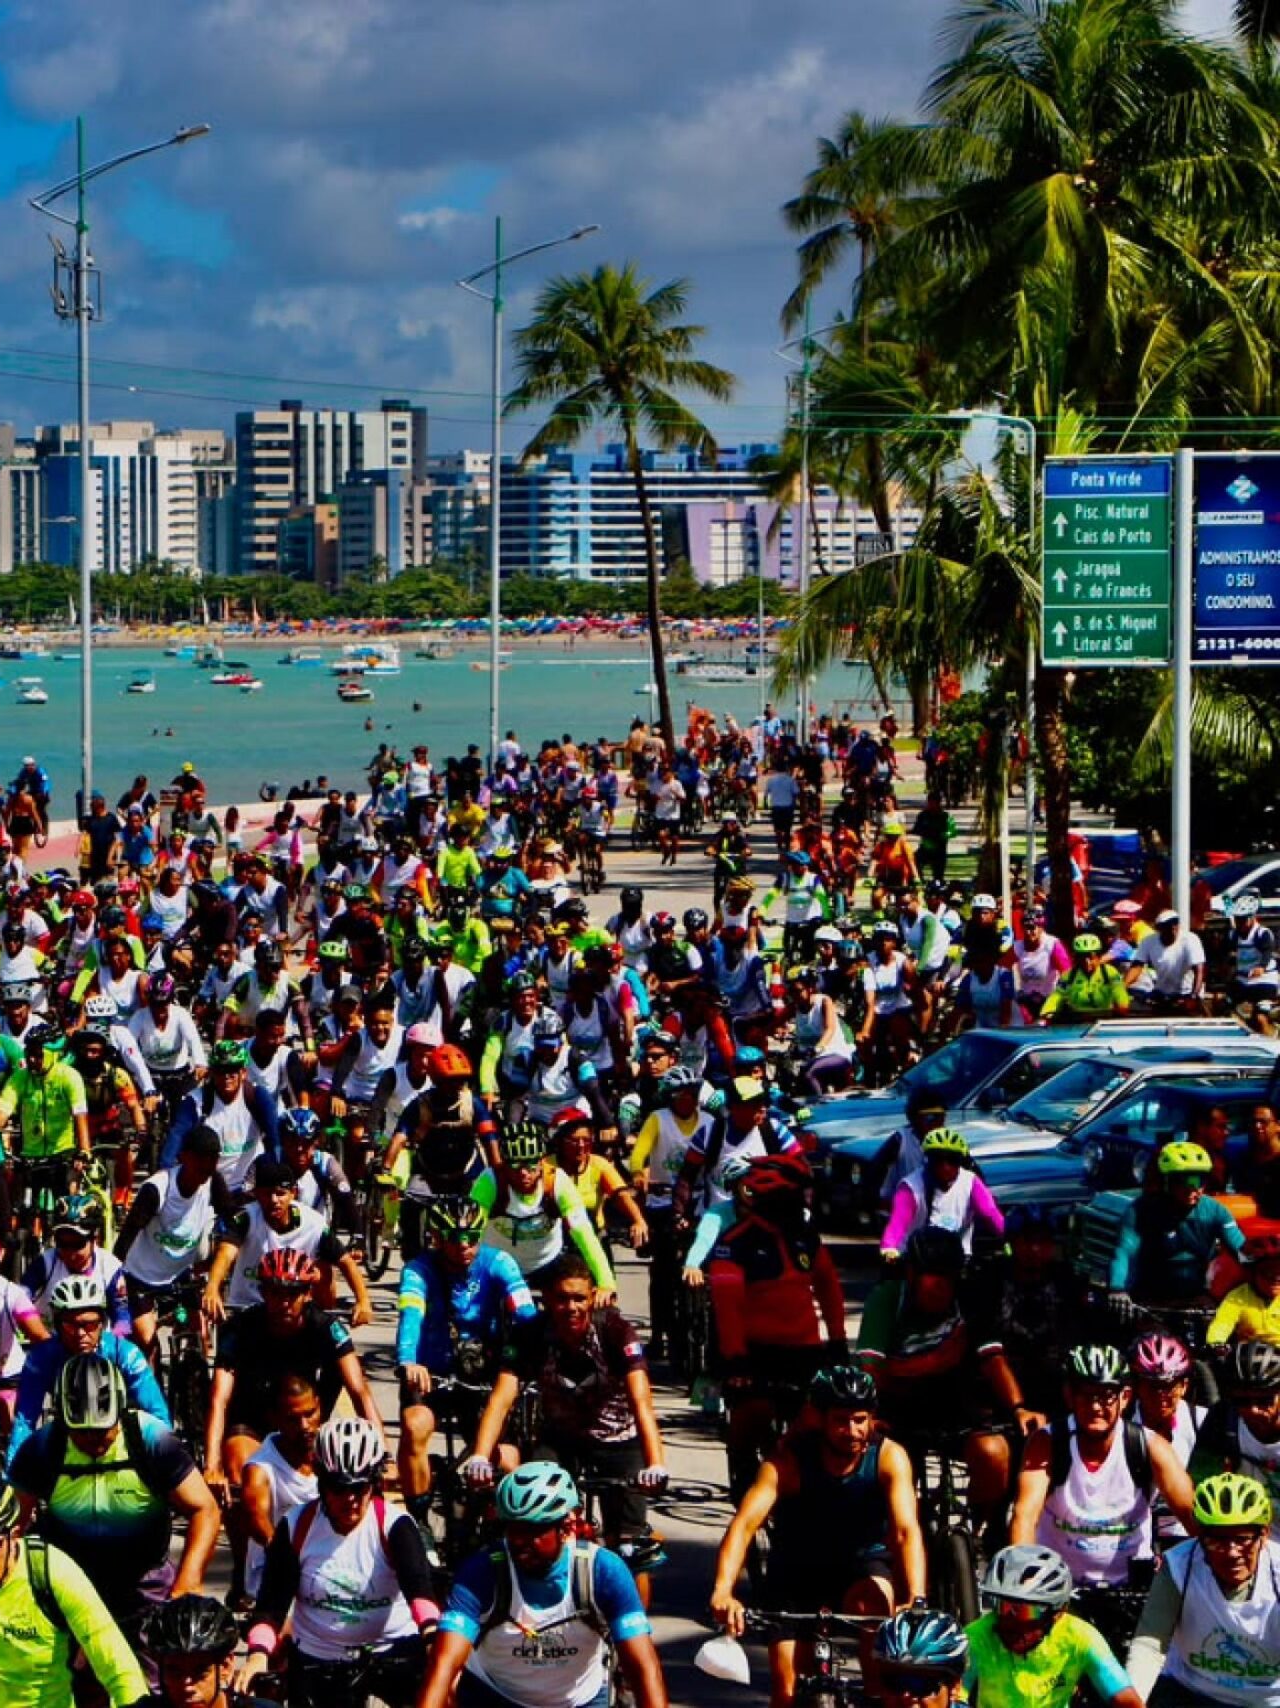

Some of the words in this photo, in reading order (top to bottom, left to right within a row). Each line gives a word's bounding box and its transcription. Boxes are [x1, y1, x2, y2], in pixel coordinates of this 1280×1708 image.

[1071, 471, 1105, 487] Ponta
[1108, 471, 1142, 487] Verde
[1075, 503, 1102, 519] Pisc.
[1107, 503, 1149, 519] Natural
[1074, 527, 1098, 544] Cais
[1101, 528, 1116, 543] do
[1119, 527, 1152, 544] Porto
[1075, 560, 1120, 580] Jaraguá
[1226, 573, 1235, 587] O
[1236, 573, 1255, 587] SEU
[1073, 582, 1086, 598] P.
[1089, 583, 1103, 598] do
[1106, 582, 1152, 598] Francês
[1073, 615, 1085, 631] B.
[1089, 615, 1103, 631] de
[1106, 614, 1117, 631] S.
[1120, 614, 1157, 634] Miguel
[1073, 636, 1112, 652] Litoral
[1115, 636, 1133, 652] Sul
[512, 1646, 578, 1658] ciclstico
